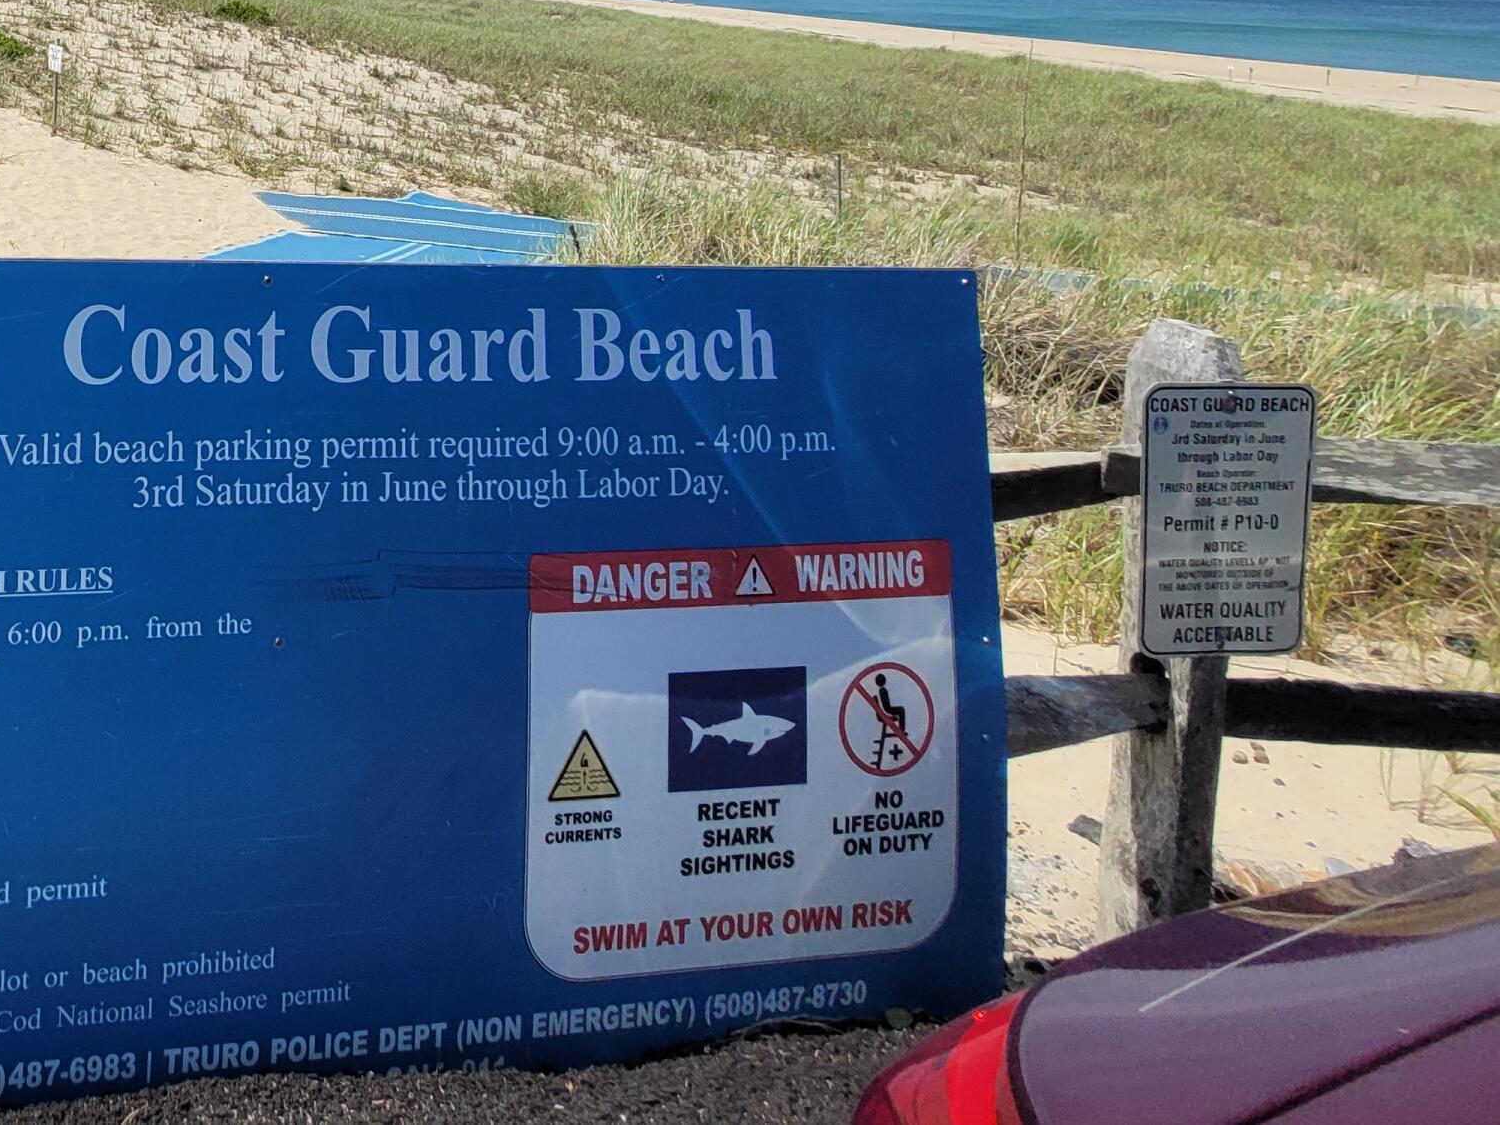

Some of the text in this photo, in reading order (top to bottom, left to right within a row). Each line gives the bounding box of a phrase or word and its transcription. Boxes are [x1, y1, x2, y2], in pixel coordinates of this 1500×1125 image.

[63, 304, 778, 385] Coast Guard Beach
[1150, 397, 1309, 413] COAST GURD BEACH
[93, 430, 185, 464] beach
[195, 429, 312, 471] parking
[321, 428, 419, 468] permit
[429, 427, 548, 466] required
[558, 427, 618, 457] 9:00
[629, 435, 684, 455] a.m.
[714, 424, 771, 453] 4:00
[780, 432, 836, 460] p.m.
[1172, 433, 1285, 447] 3rd Saturday in June
[1178, 450, 1278, 465] through Labor Day
[133, 467, 728, 512] 3rd Saturday in June through Labor Day.
[1159, 480, 1295, 493] TRURO BEACH DEPARTMENT
[1164, 515, 1215, 532] Permit
[1220, 516, 1229, 530] #
[15, 566, 113, 592] RULES
[573, 561, 712, 603] DANGER
[795, 550, 924, 592] WARNING
[1160, 601, 1286, 619] WATER QUALITY
[8, 621, 61, 645] 6:00
[77, 625, 128, 648] p.m.
[146, 616, 202, 638] from
[217, 613, 252, 635] the
[698, 798, 780, 822] RECENT
[875, 790, 903, 809] NO
[555, 810, 613, 826] STRONG
[833, 810, 944, 835] LIFEGUARD
[545, 827, 622, 844] CURRENTS
[703, 825, 774, 848] SHARK
[844, 832, 933, 856] ON DUTY
[680, 850, 795, 876] SIGHTINGS
[27, 875, 107, 908] permit
[573, 899, 912, 954] SWIM AT YOUR OWN RISK
[0, 969, 28, 992] lot
[44, 971, 68, 987] or
[83, 958, 147, 984] beach
[163, 947, 274, 984] prohibited
[57, 997, 152, 1027] National
[169, 991, 267, 1017] Seashore
[282, 980, 350, 1013] permit
[163, 1040, 259, 1074] TRURO
[271, 1029, 368, 1064] POLICE
[379, 1022, 447, 1053] DEPT
[457, 1014, 522, 1051] (NON
[532, 997, 695, 1038] EMERGENCY)
[704, 980, 867, 1028] (508)487-8730
